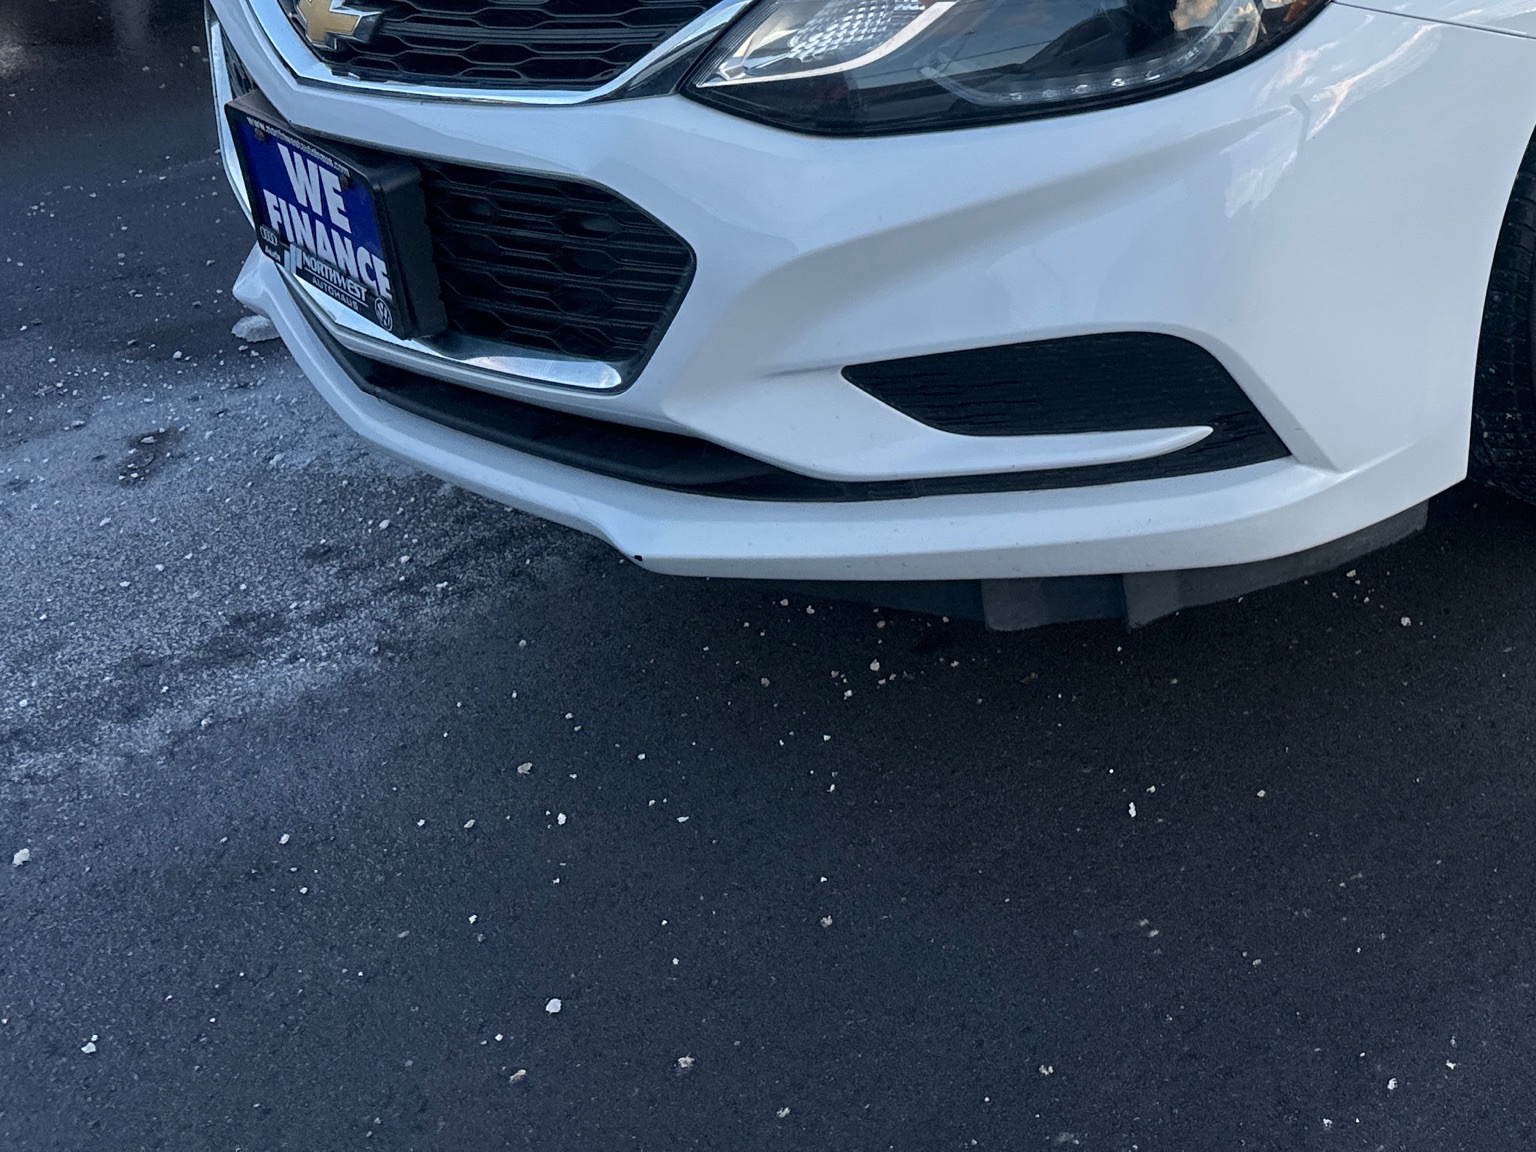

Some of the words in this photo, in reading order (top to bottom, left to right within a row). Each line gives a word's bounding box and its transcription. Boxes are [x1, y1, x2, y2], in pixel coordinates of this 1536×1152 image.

[277, 143, 352, 234] WE
[263, 188, 393, 300] FINANCE
[303, 252, 367, 301] NORTHWEST
[312, 277, 359, 311] AUTOHAUS
